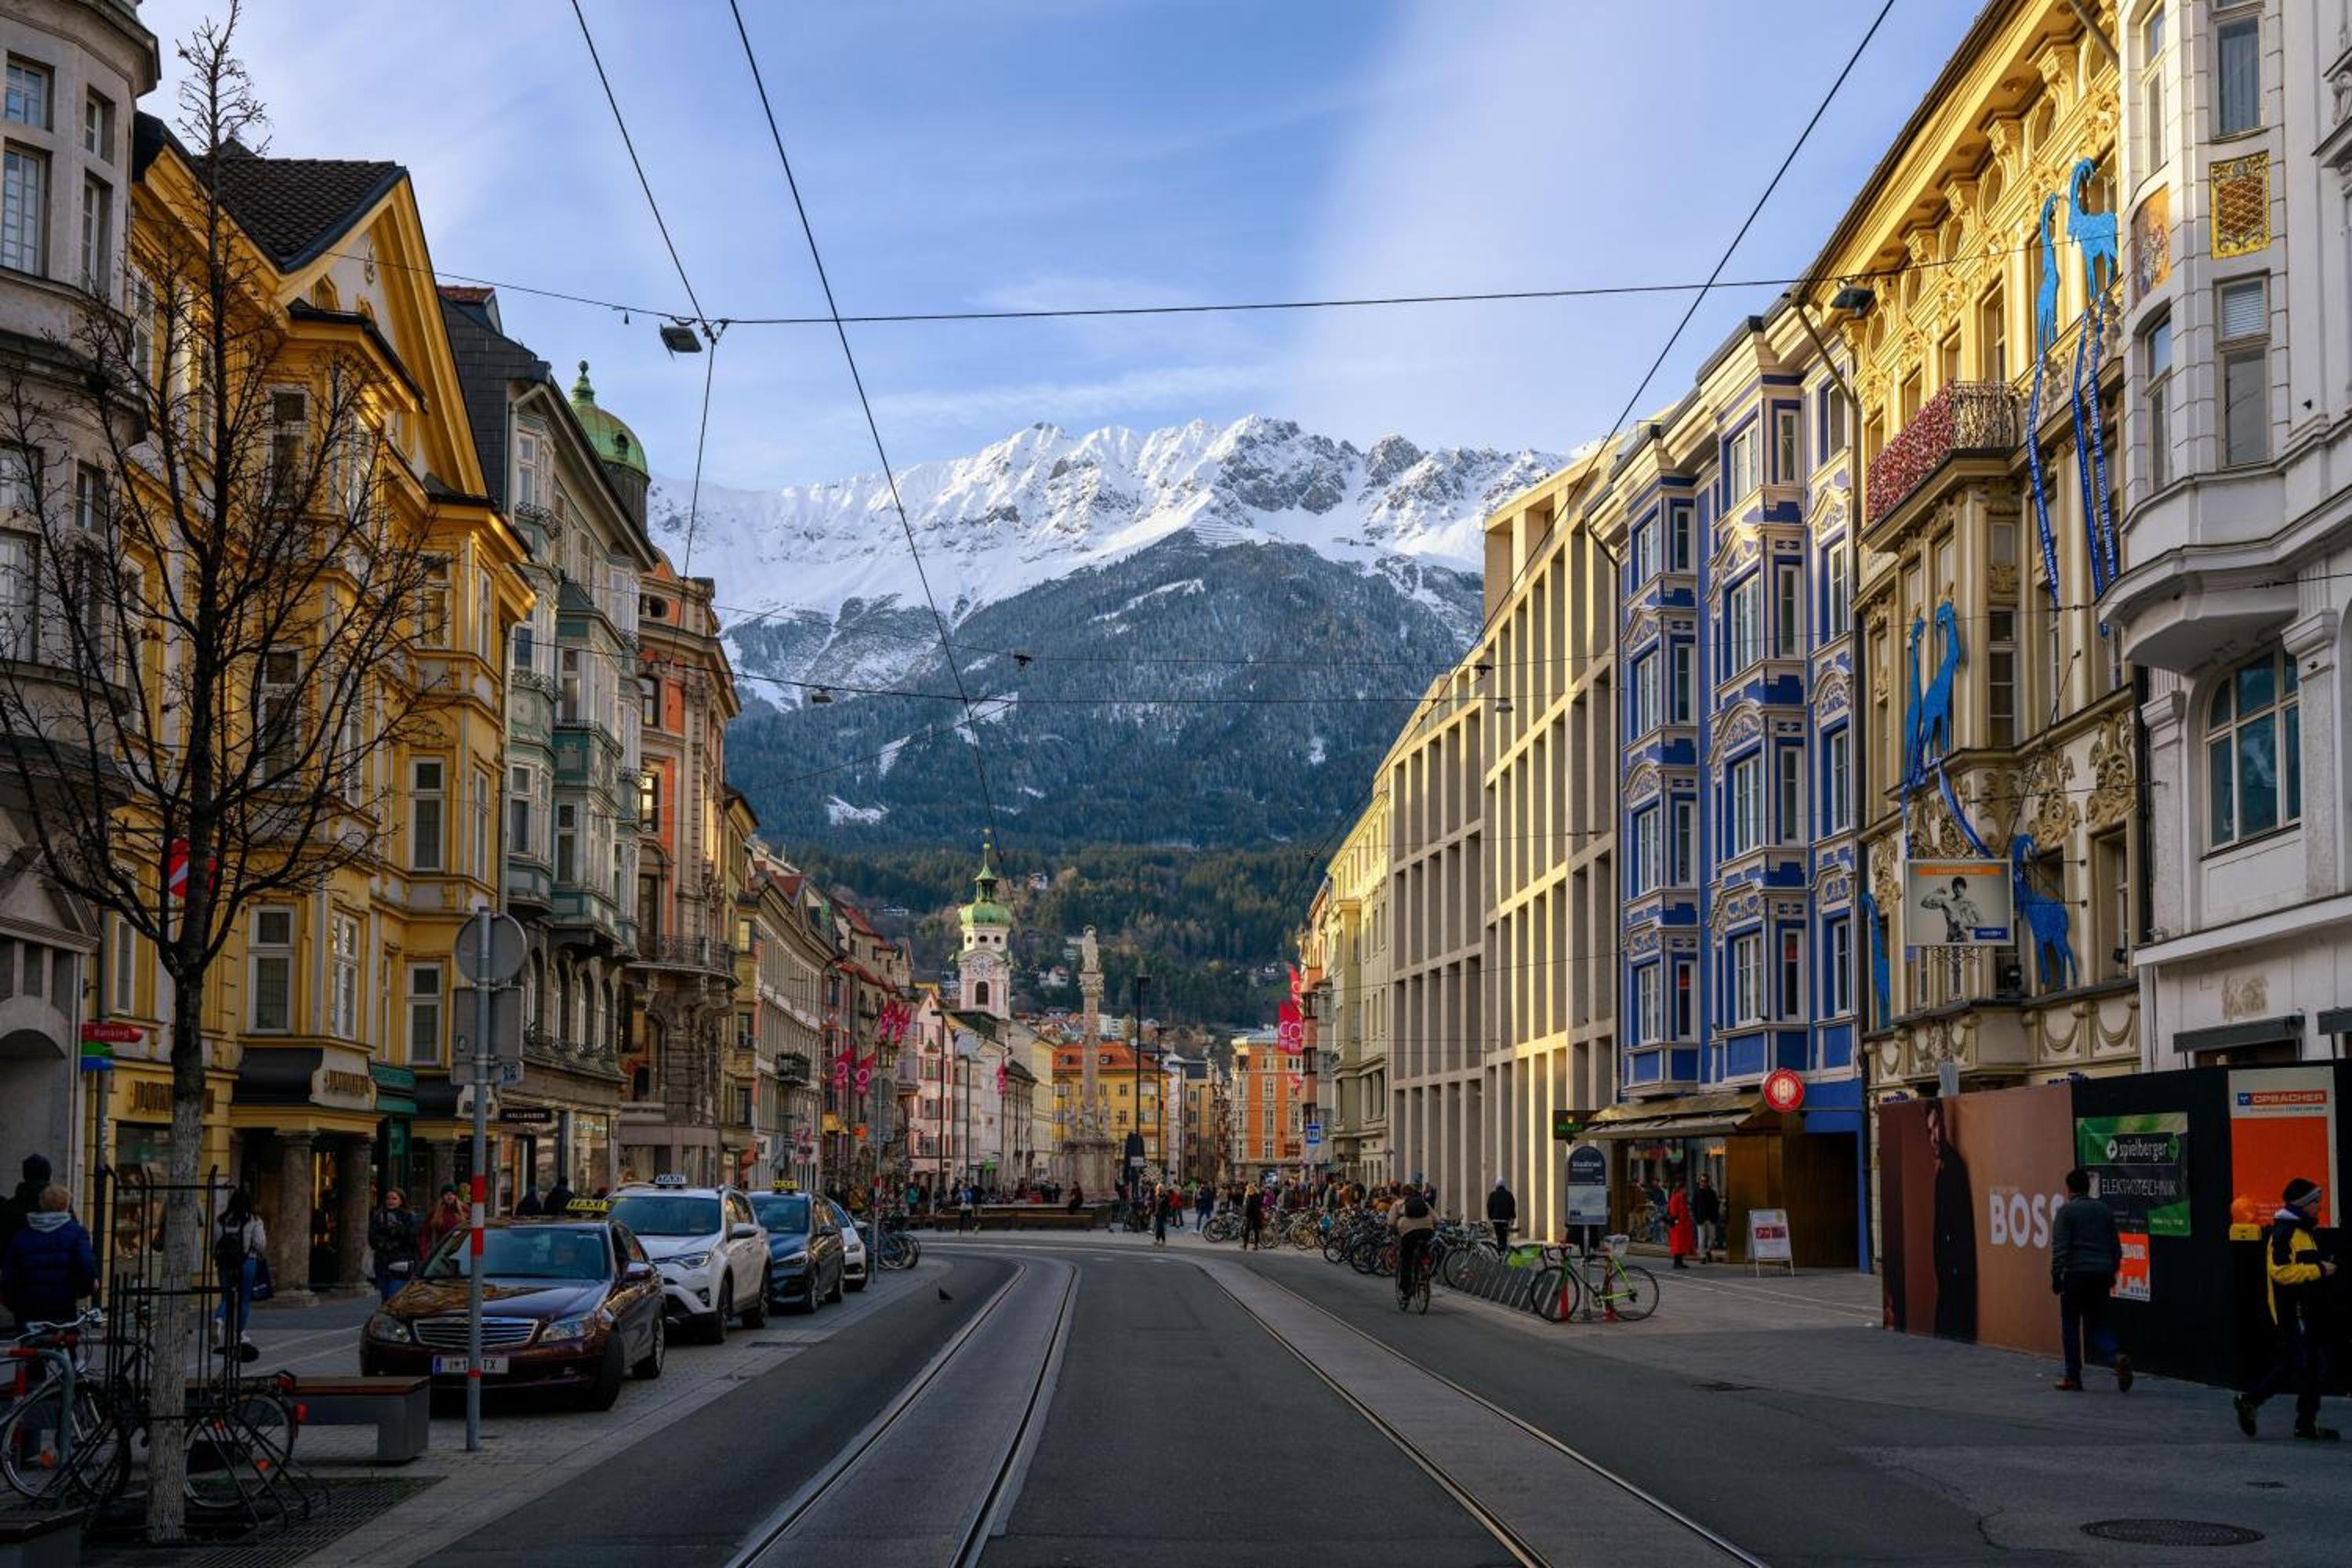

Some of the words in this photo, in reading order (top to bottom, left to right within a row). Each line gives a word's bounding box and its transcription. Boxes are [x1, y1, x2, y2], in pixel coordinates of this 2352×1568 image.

[2119, 1138, 2168, 1162] spielberger
[2101, 1178, 2177, 1196] ELEKTROTECHNIK
[569, 1200, 603, 1210] TAXI
